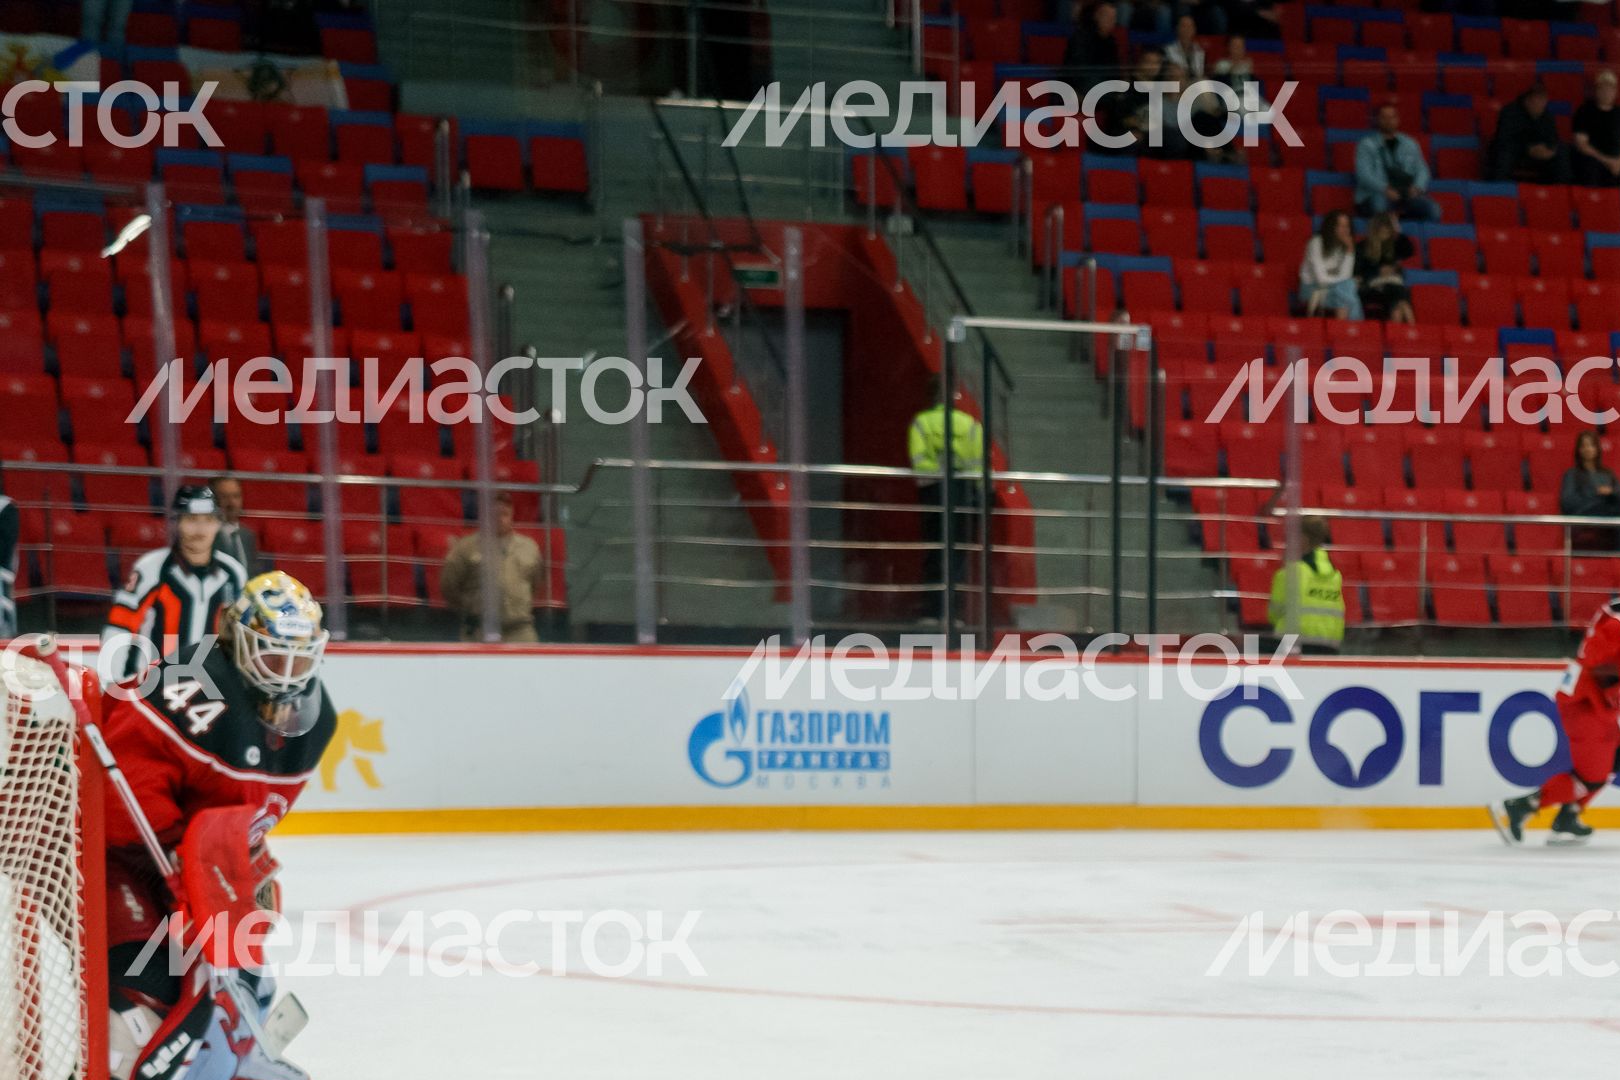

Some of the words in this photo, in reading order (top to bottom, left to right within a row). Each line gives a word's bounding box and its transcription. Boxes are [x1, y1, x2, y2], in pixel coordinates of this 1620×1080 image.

[163, 680, 228, 735] 44
[756, 710, 891, 744] ГАЗПРОМ
[758, 751, 891, 770] ТРАНСГАЗ
[756, 774, 891, 789] МОСКВА
